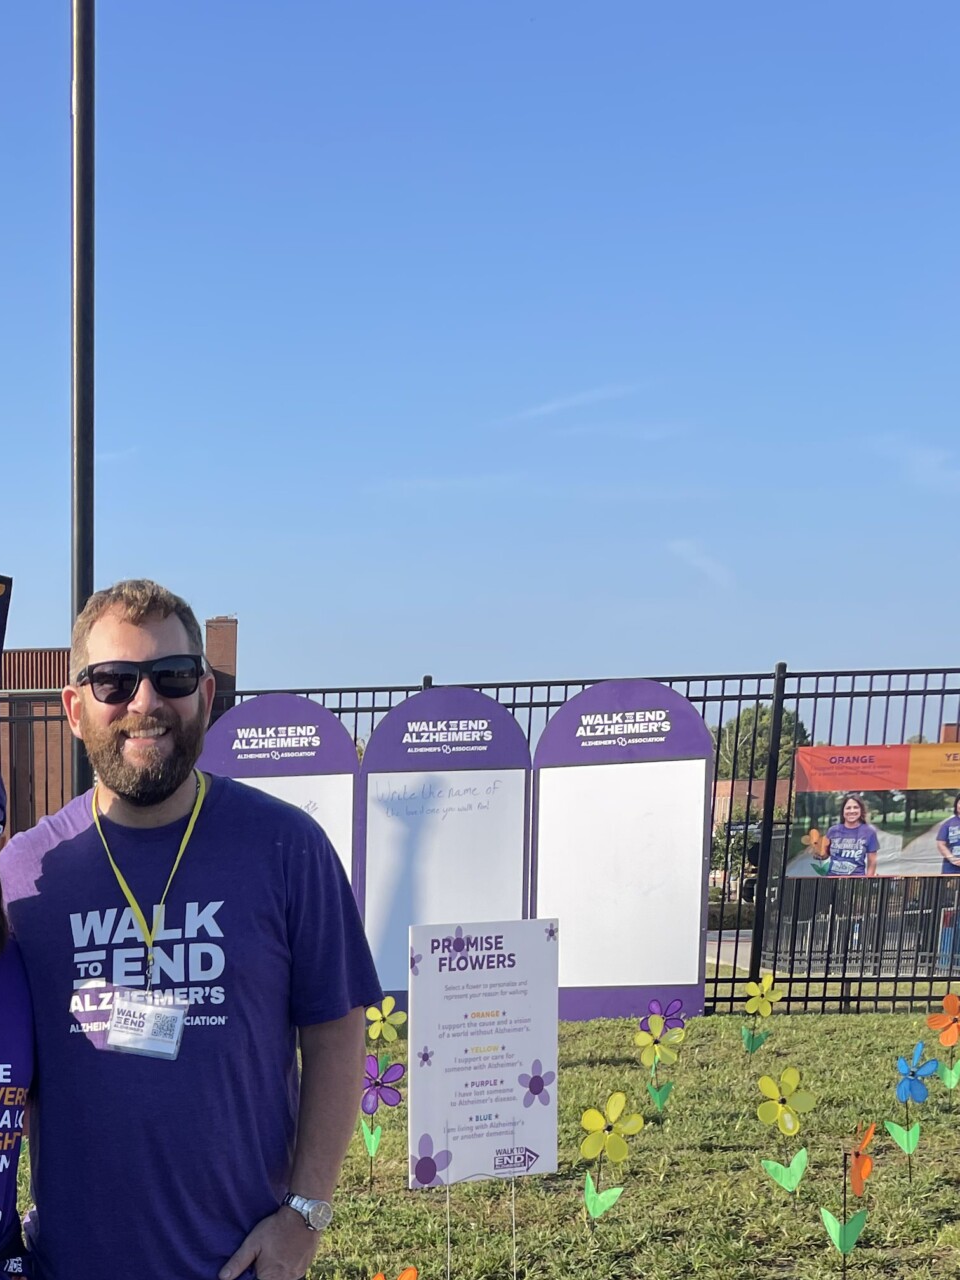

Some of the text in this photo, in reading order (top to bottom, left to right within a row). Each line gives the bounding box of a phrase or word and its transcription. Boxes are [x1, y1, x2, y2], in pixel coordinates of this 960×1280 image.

[581, 713, 623, 725] WALK
[636, 711, 666, 722] END
[237, 727, 276, 738] WALK
[288, 726, 316, 736] END
[407, 721, 447, 732] WALK
[460, 720, 488, 730] END
[576, 721, 671, 737] ALZHEIMER'S
[232, 736, 321, 750] ALZHEIMER'S
[402, 731, 493, 743] ALZHEIMER'S
[829, 755, 876, 765] ORANGE
[448, 787, 480, 799] name
[485, 780, 502, 796] of
[70, 901, 224, 948] WALK
[431, 935, 504, 954] PROMISE
[77, 942, 225, 986] TO END
[438, 953, 516, 973] FLOWERS
[117, 1008, 146, 1020] WALK
[471, 1010, 500, 1019] ORANGE
[70, 1020, 111, 1033] ALZHEIM
[184, 1016, 226, 1026] CIATION
[124, 1018, 145, 1028] END
[442, 1022, 466, 1031] support
[470, 1027, 493, 1036] without
[471, 1045, 499, 1054] YELLOW
[445, 1065, 472, 1073] someone
[471, 1079, 498, 1088] PURPLE
[495, 1155, 525, 1165] END
